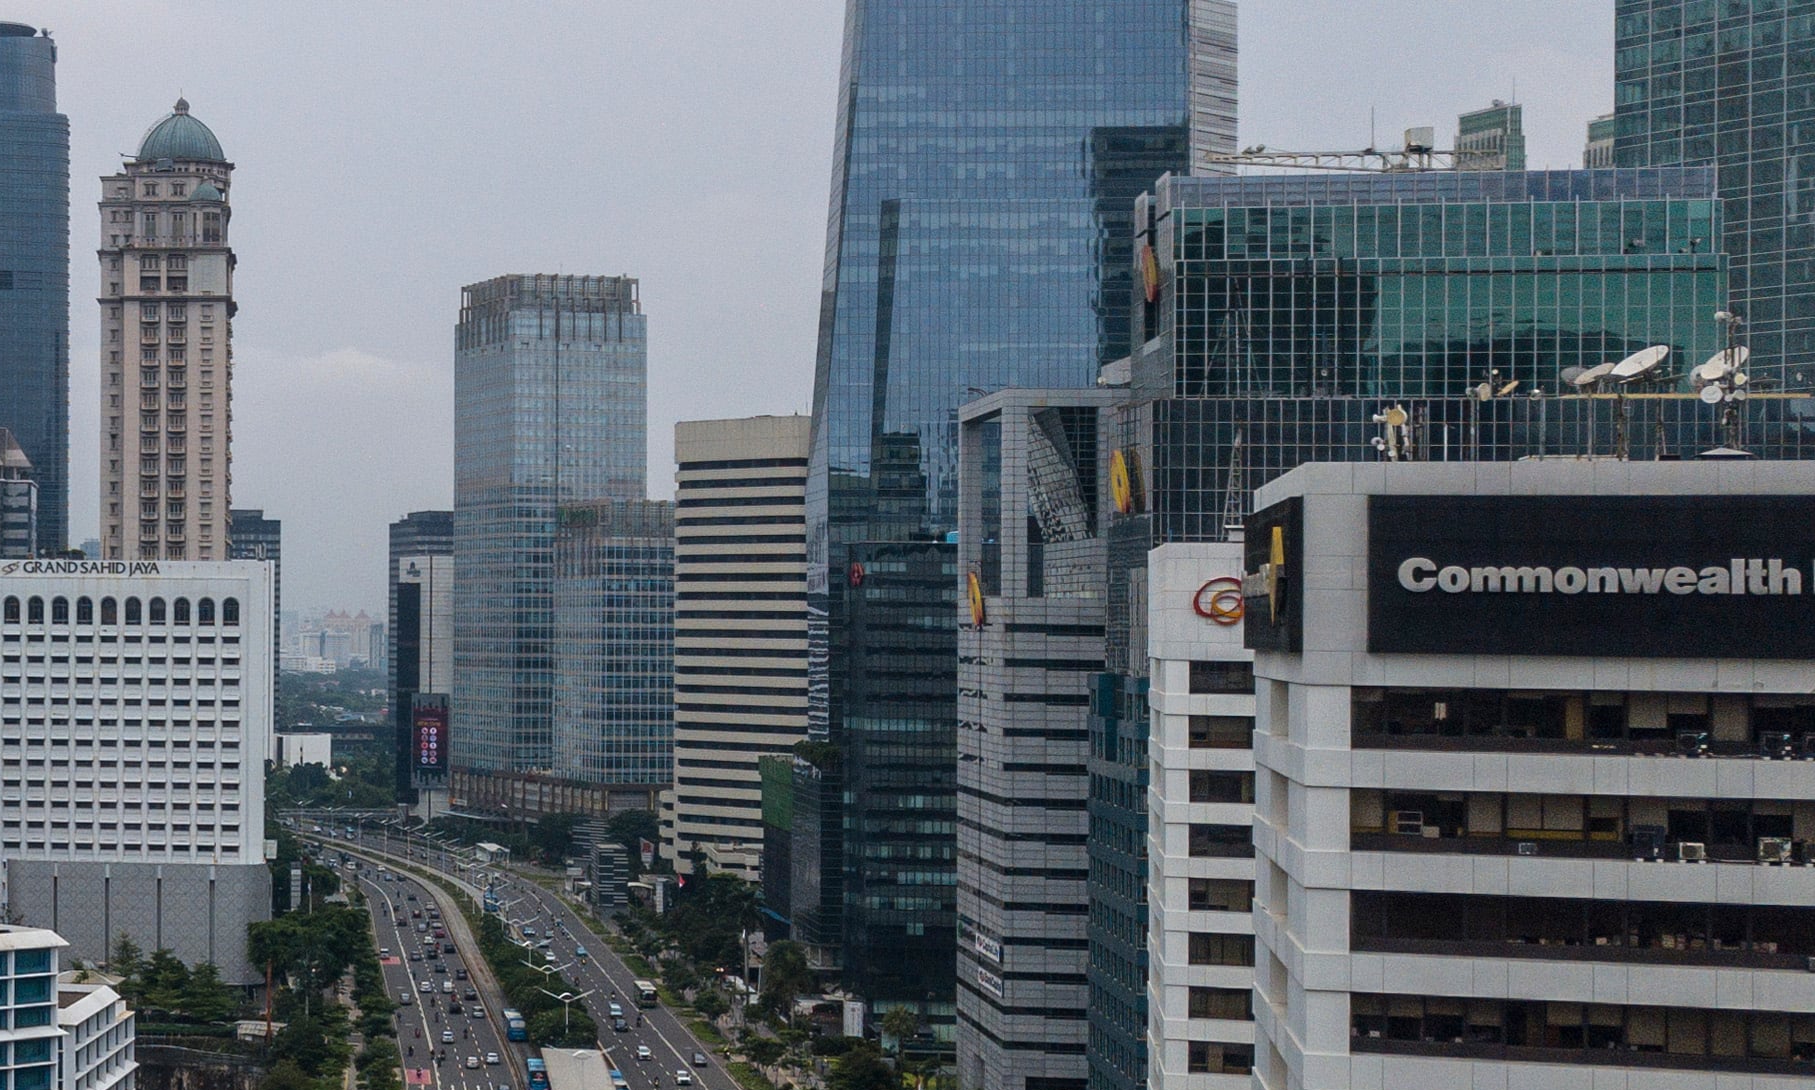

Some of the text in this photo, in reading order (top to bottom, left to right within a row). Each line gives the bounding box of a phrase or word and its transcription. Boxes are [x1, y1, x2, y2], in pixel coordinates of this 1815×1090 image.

[23, 561, 160, 577] GRAND SAHID JAYA
[1397, 556, 1802, 596] Commonwealth
